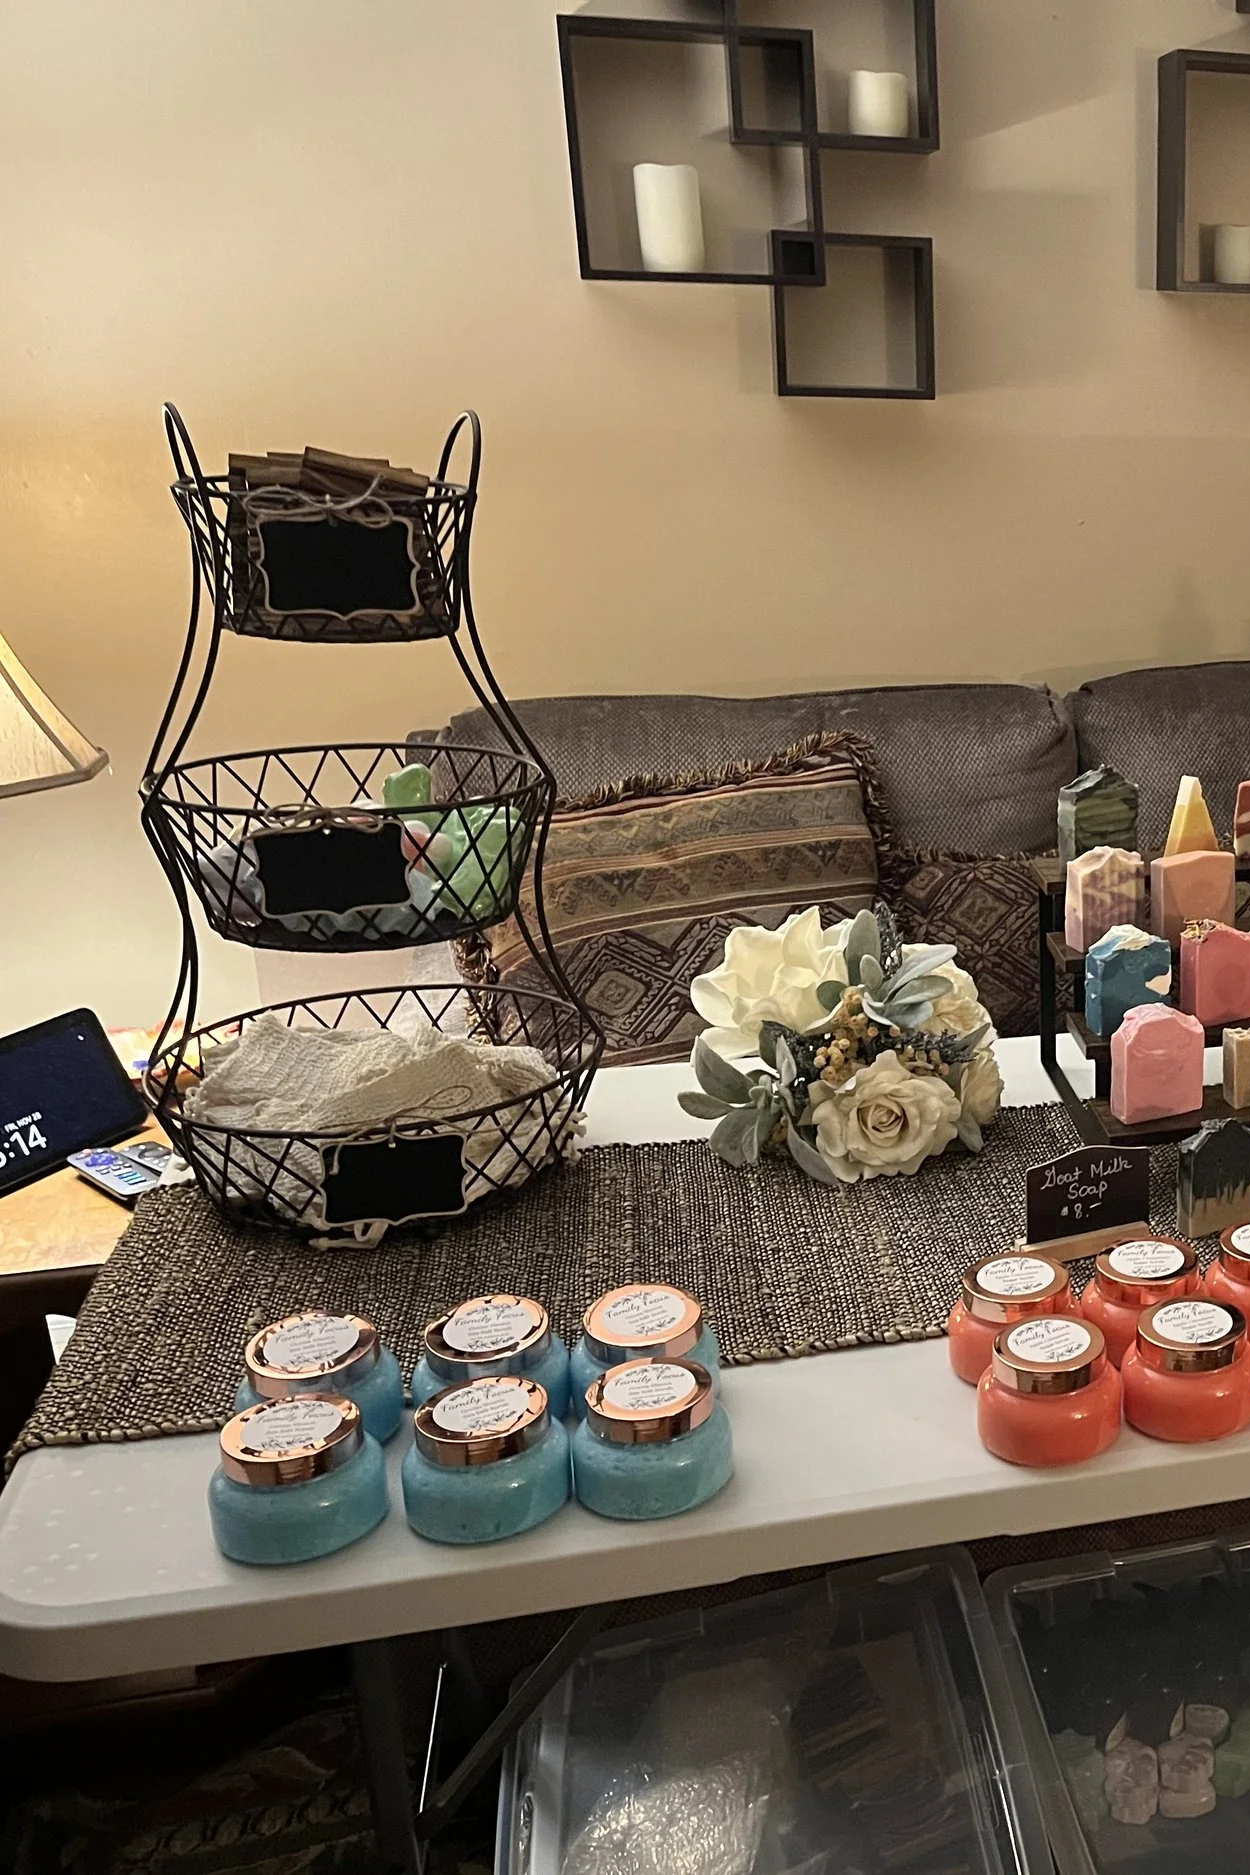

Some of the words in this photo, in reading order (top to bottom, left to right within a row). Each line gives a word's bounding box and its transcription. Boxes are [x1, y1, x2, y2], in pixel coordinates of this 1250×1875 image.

[16, 1115, 32, 1127] NOV
[1040, 1165, 1082, 1190] Goat
[1090, 1157, 1133, 1179] Milk
[1067, 1181, 1108, 1200] Soap
